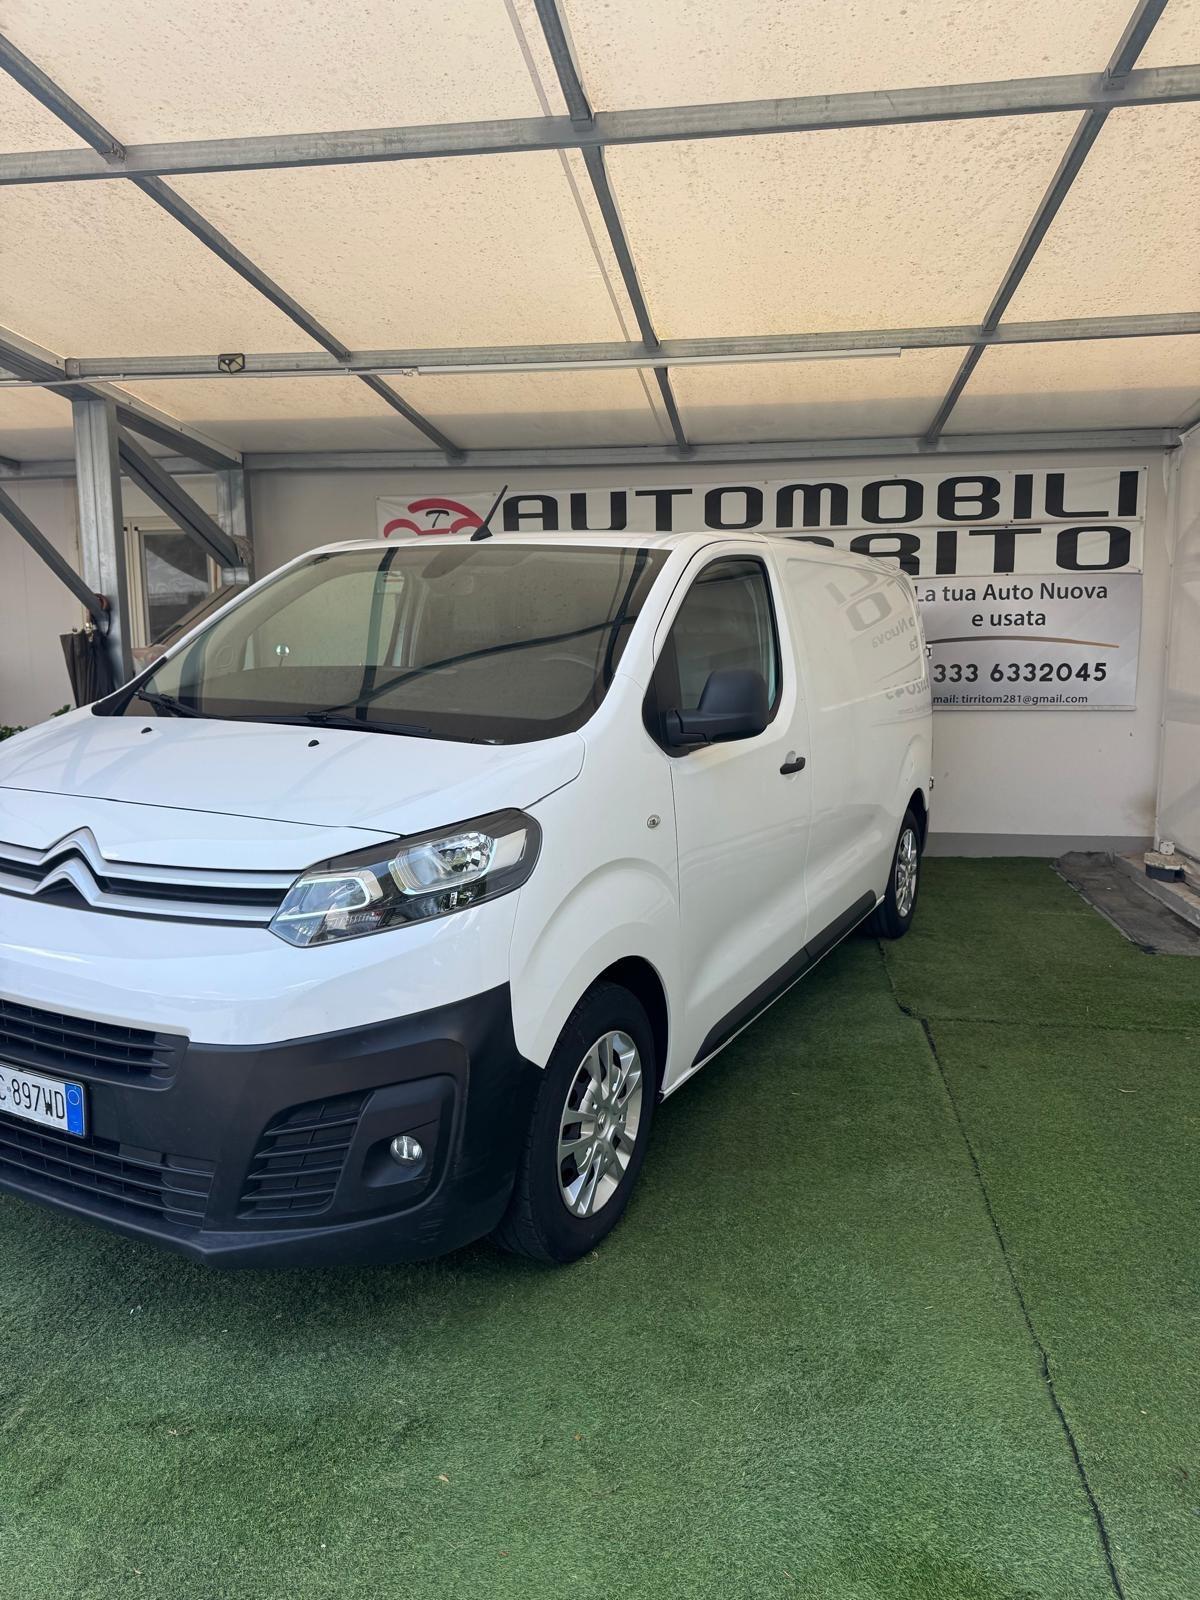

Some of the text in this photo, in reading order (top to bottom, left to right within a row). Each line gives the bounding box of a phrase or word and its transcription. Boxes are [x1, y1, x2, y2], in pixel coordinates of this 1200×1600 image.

[503, 470, 1139, 532] AUTOMOBILI
[783, 525, 1132, 576] RITO
[942, 586, 976, 602] tua
[983, 583, 1034, 601] Auto
[1040, 582, 1108, 600] Nuova
[971, 610, 1046, 627] e usata
[933, 662, 1108, 683] 333 6332045
[961, 694, 1088, 706] tirritom281@gmail.com
